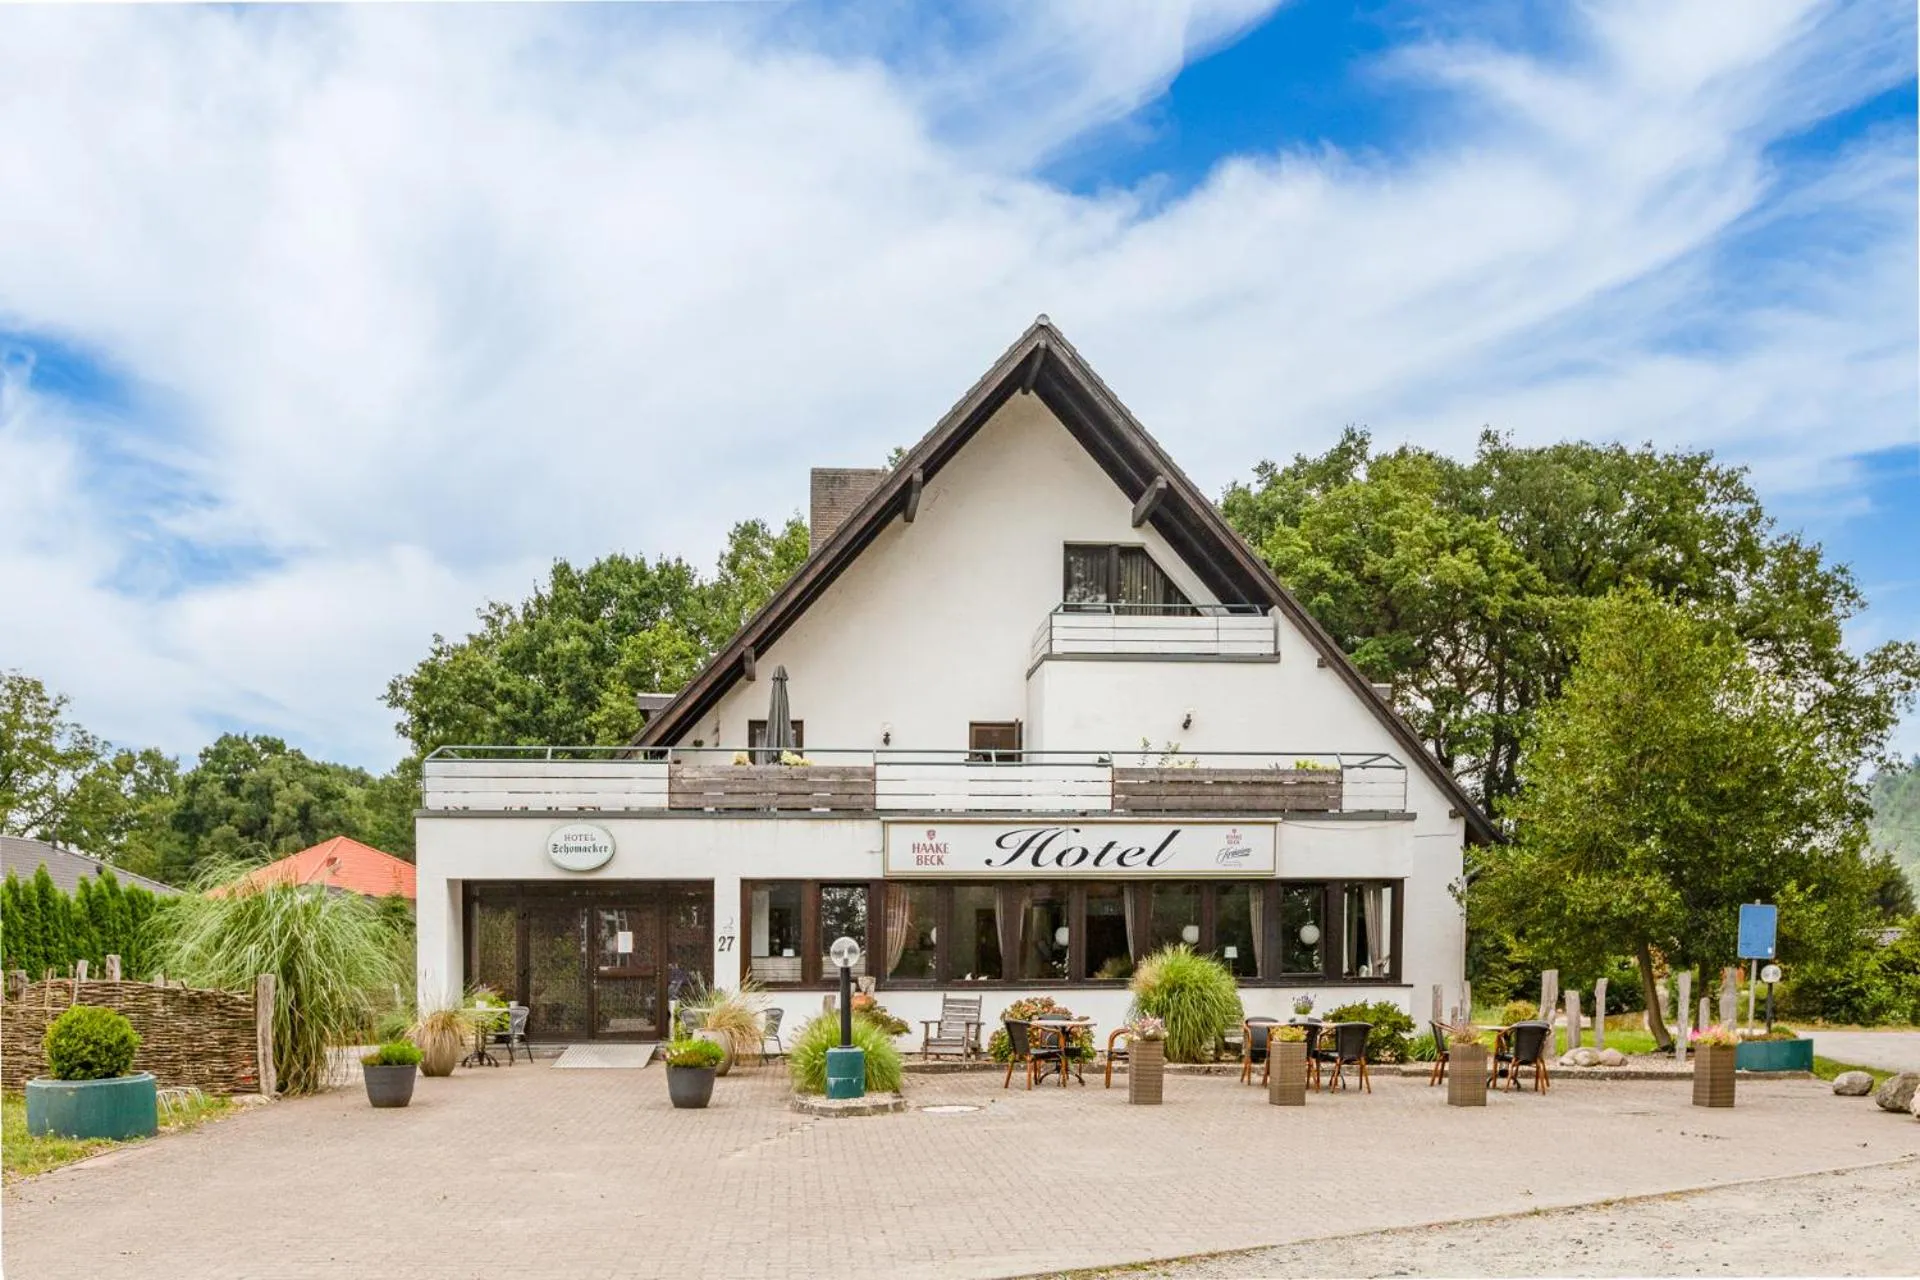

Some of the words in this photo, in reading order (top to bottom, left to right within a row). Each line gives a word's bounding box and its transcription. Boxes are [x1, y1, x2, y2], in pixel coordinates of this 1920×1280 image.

[564, 833, 596, 841] HOTEL
[912, 842, 950, 854] HAAKE
[985, 827, 1181, 868] Hotel
[916, 854, 945, 866] BECK
[718, 936, 735, 952] 27
